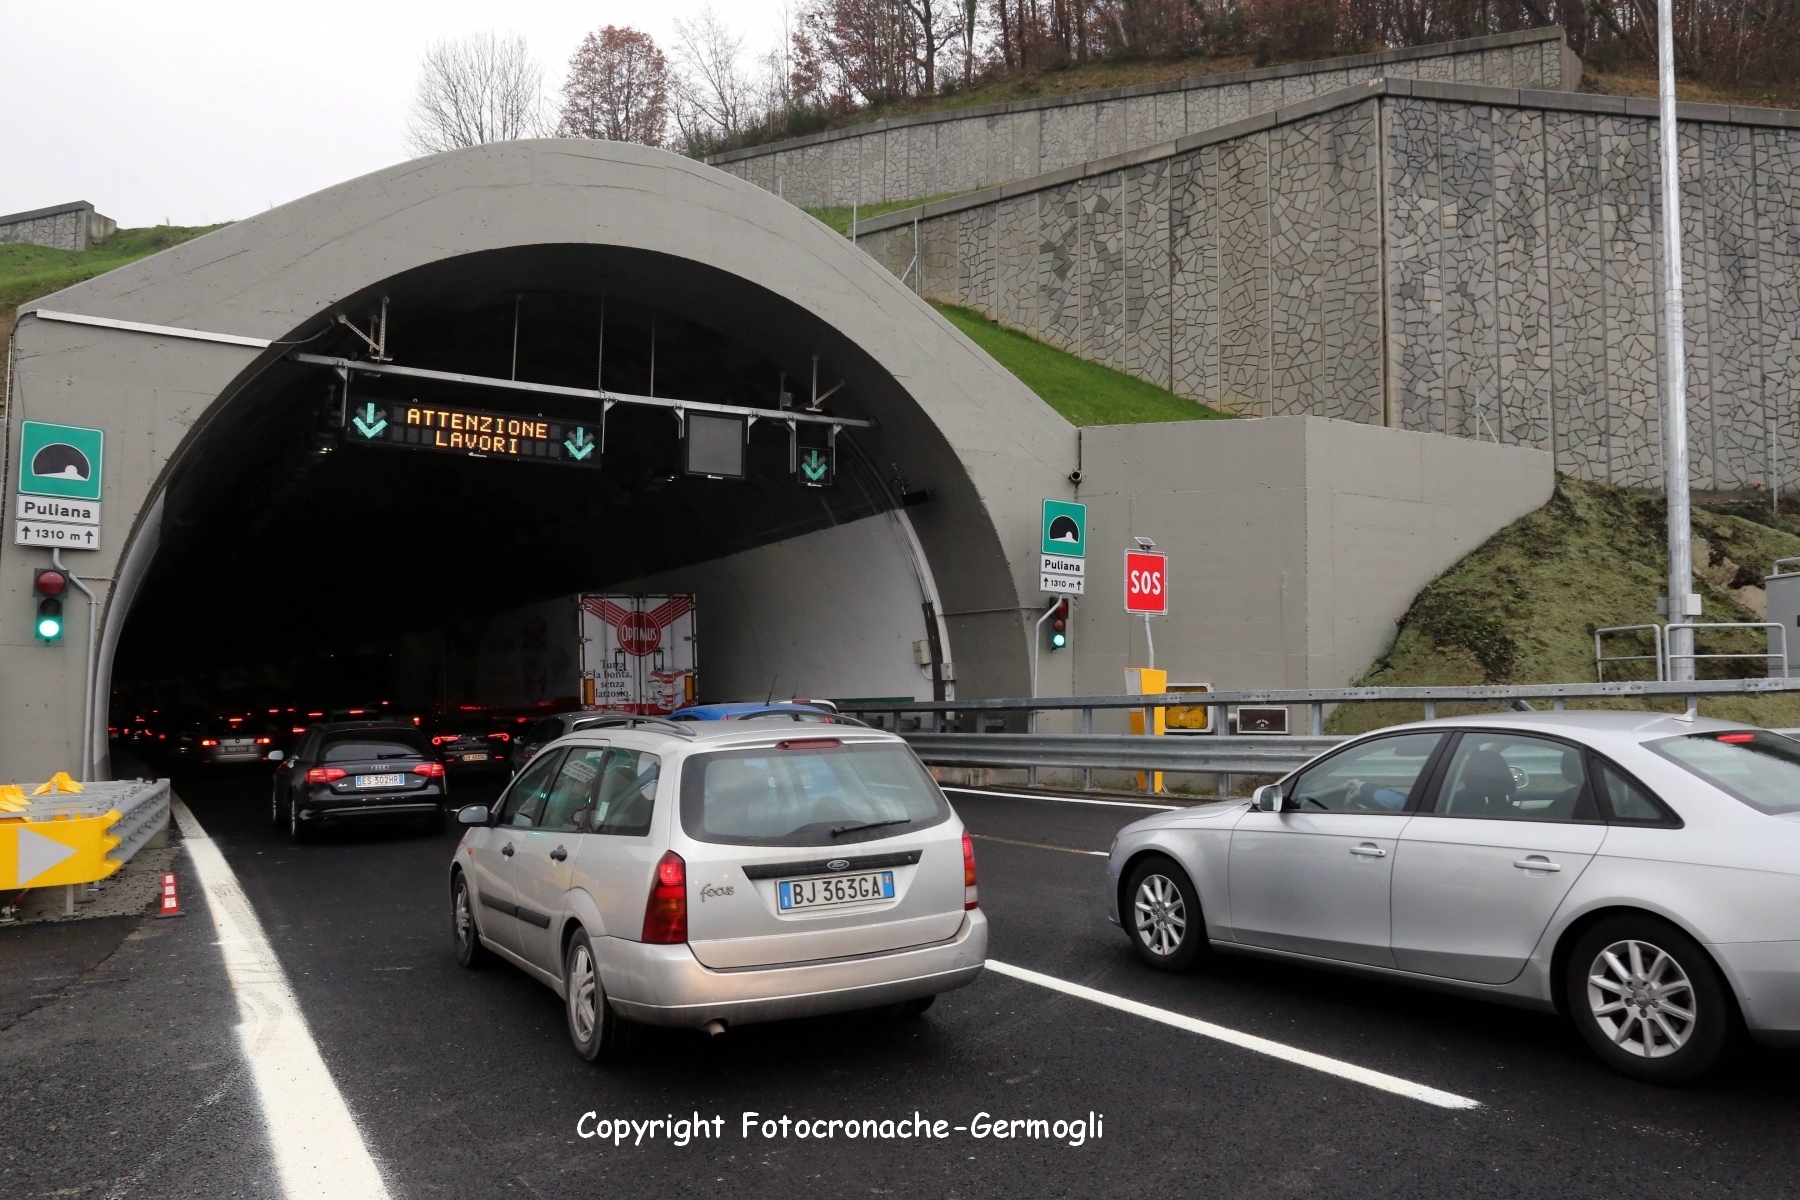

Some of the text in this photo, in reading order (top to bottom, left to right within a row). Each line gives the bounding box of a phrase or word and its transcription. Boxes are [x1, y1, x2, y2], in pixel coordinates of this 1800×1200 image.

[407, 408, 548, 439] ATTENZIONE
[436, 430, 518, 454] LAVORI
[24, 501, 91, 519] Puliana
[36, 529, 80, 541] 1310 m
[1044, 559, 1081, 572] Puliana
[1050, 579, 1067, 589] 1310
[1130, 569, 1161, 596] SOS
[601, 681, 625, 689] senza
[362, 775, 399, 785] ES 302HR
[792, 883, 816, 905] BJ
[823, 876, 881, 902] 363GA
